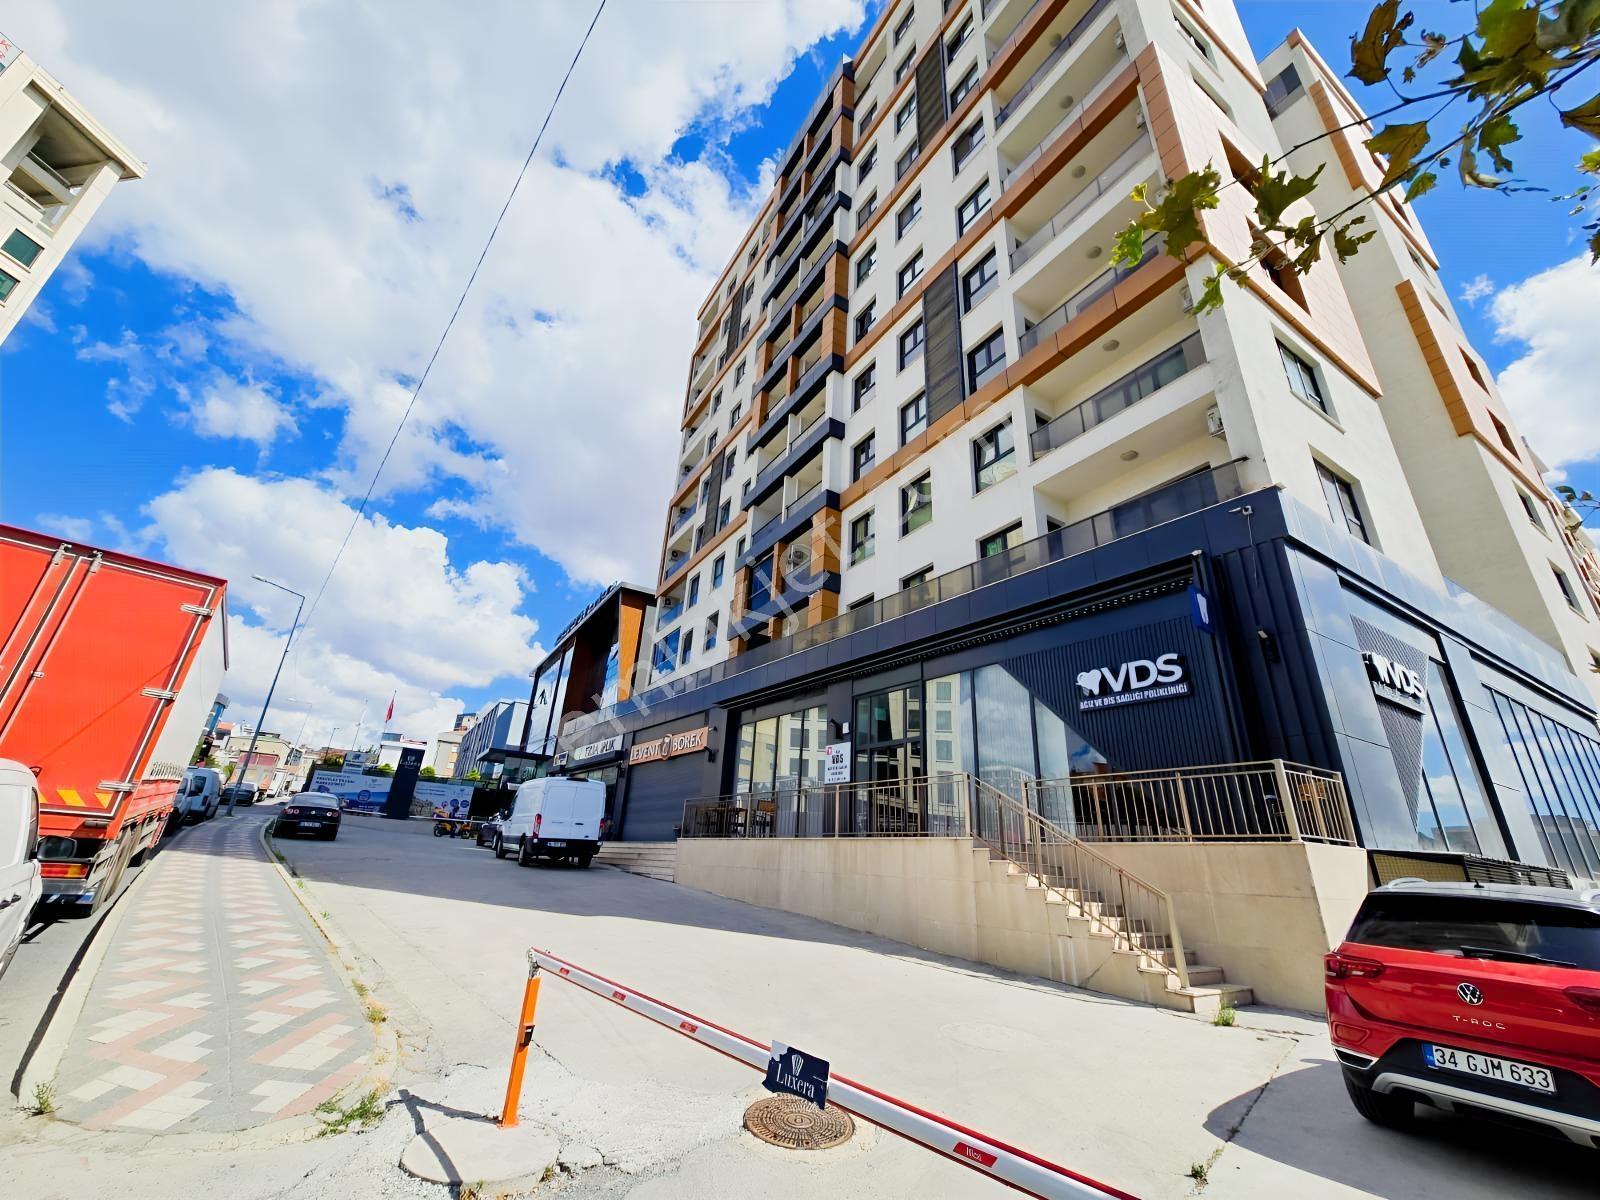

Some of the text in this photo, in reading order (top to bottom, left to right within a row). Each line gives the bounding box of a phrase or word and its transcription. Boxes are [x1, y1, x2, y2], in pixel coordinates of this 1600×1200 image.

[1100, 653, 1183, 692] VDS
[1385, 657, 1425, 699] VDS
[1452, 1015, 1506, 1030] T-ROC
[776, 1063, 815, 1098] Luxera
[1434, 1048, 1550, 1088] 34 GJM 633
